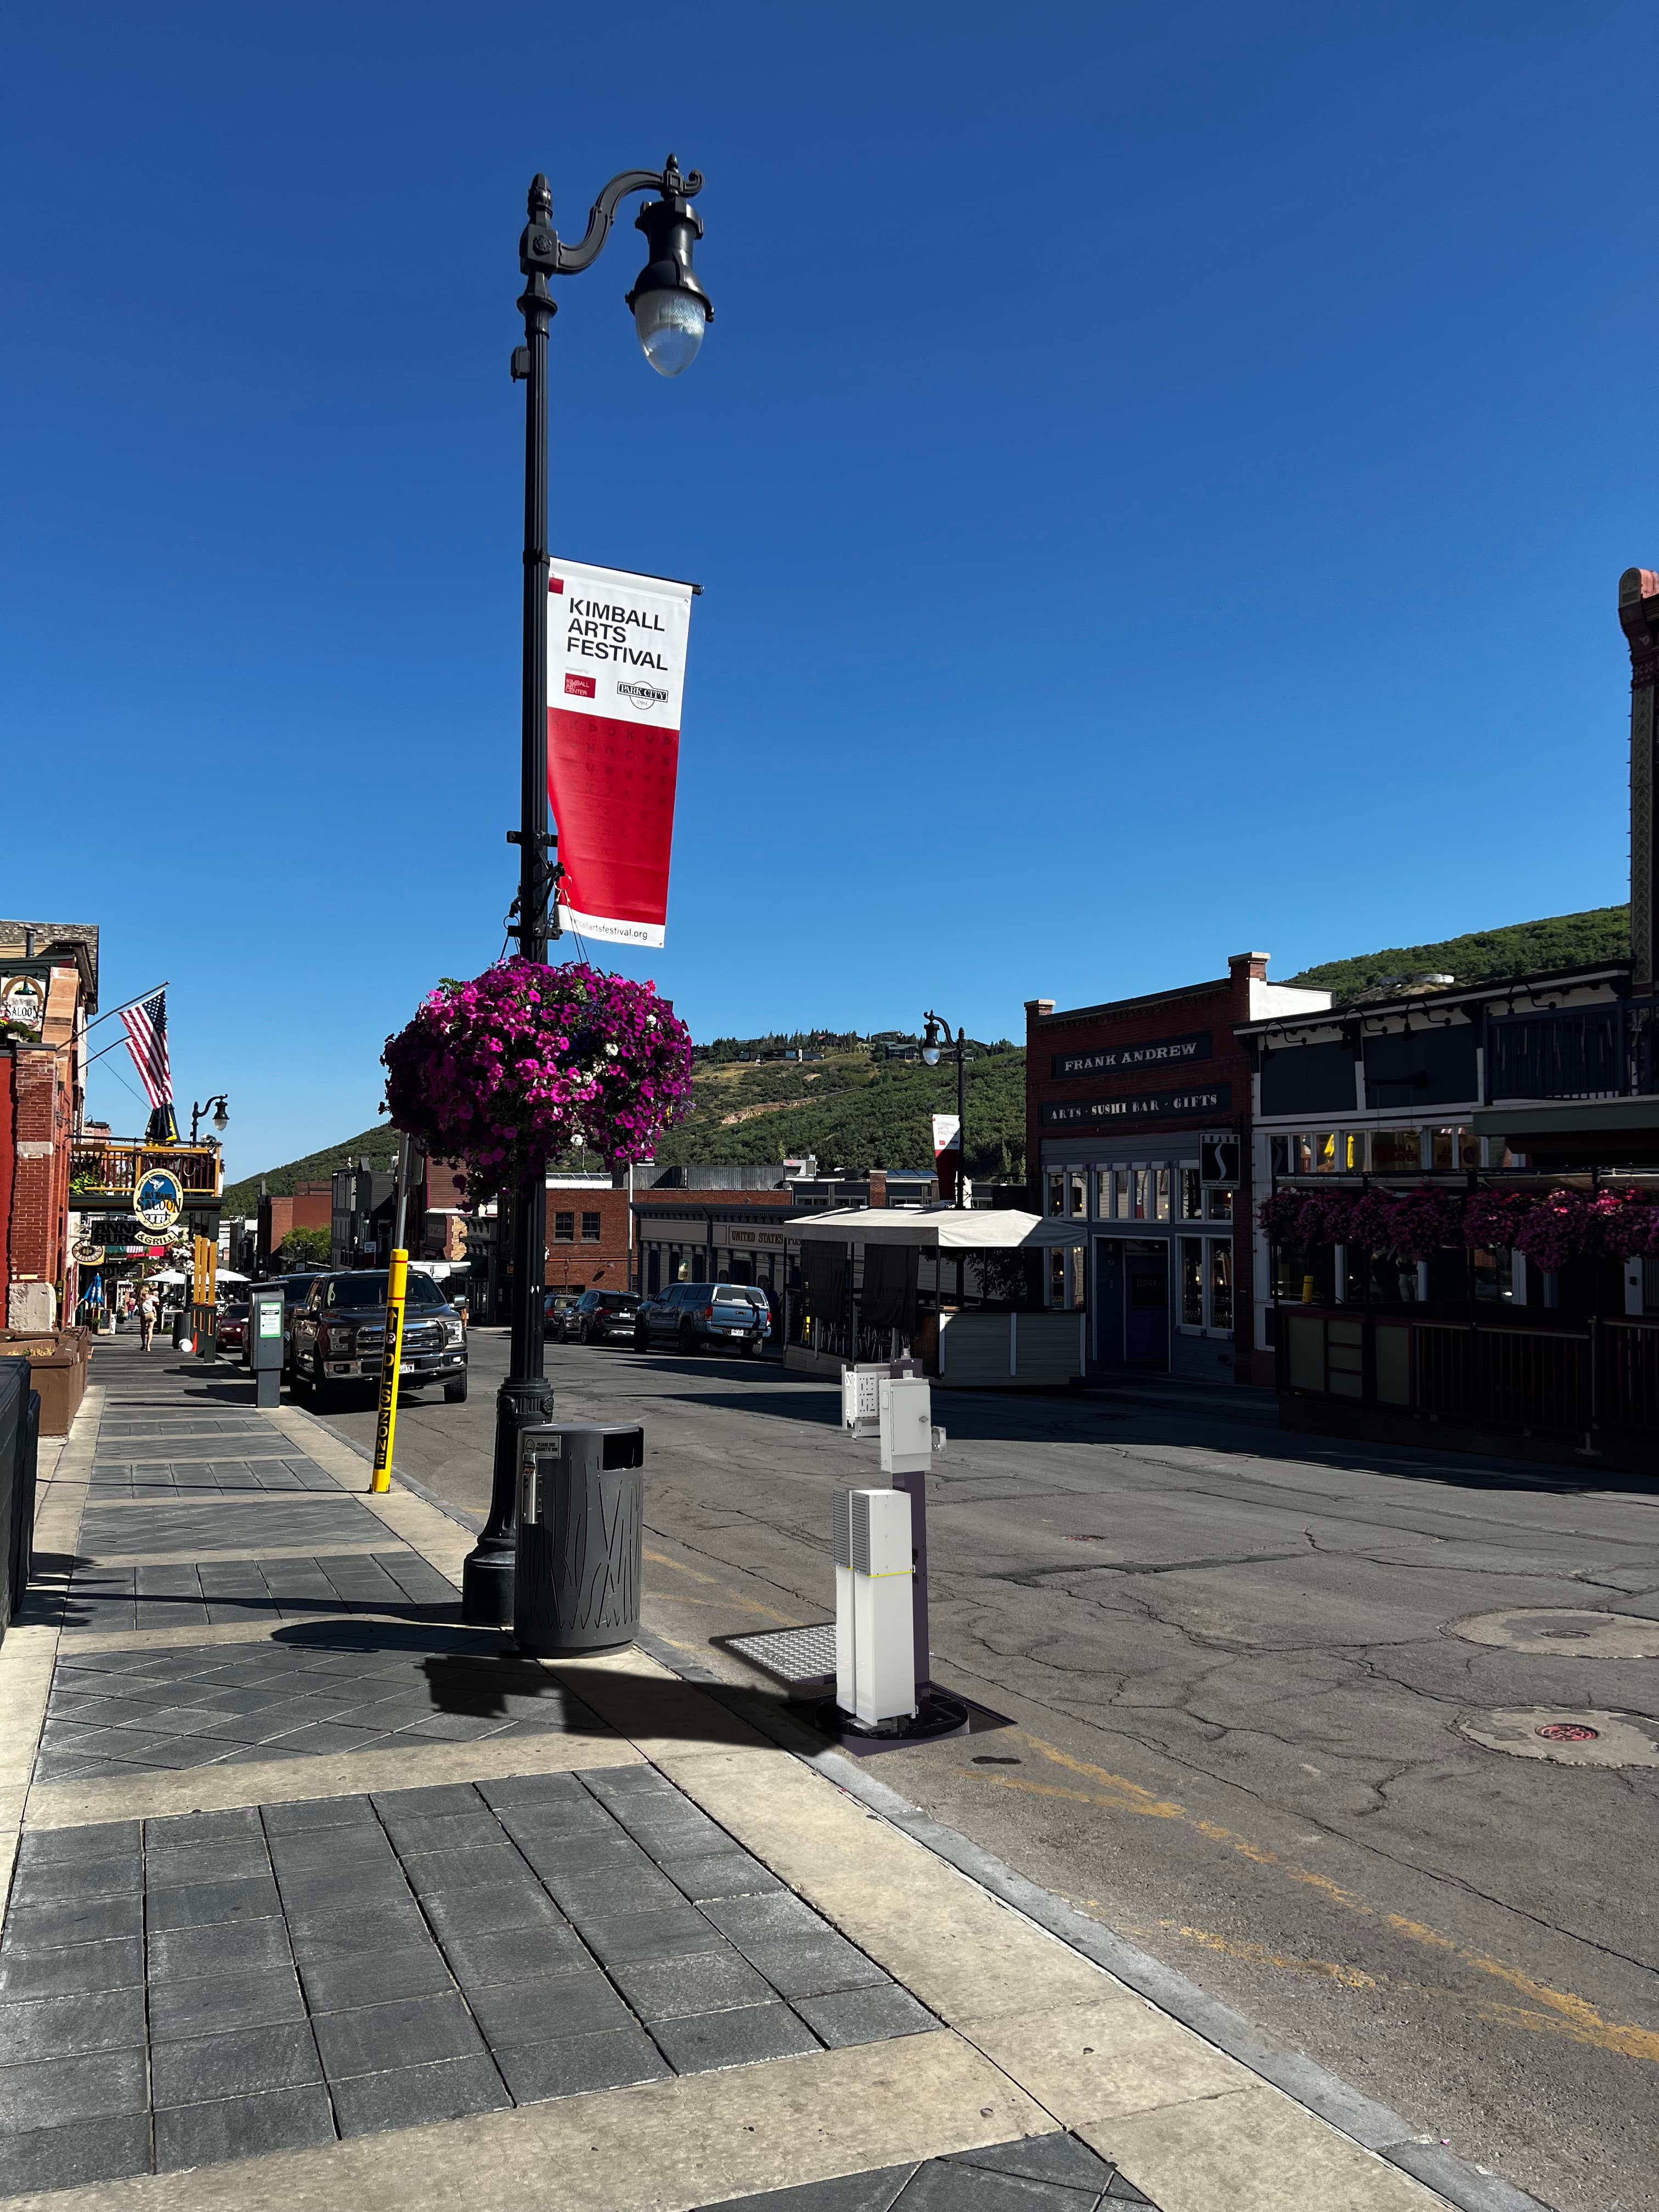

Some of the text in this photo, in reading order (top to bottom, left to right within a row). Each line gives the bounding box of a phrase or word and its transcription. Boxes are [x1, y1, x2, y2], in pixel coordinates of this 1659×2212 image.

[569, 597, 665, 631] KIMBALL
[567, 618, 627, 643] ARTS
[567, 636, 668, 671] FESTIVAL
[565, 687, 588, 696] CENTER
[566, 678, 590, 688] KIMBALL
[620, 684, 665, 699] PARK CITY
[1064, 1042, 1198, 1072] FRANK ANDREW
[1050, 1093, 1218, 1120] ARTS SUSHI BAR GIFTS
[145, 1191, 173, 1200] NO NAME
[136, 1196, 182, 1213] SALOON
[731, 1231, 755, 1242] UNITED
[758, 1233, 783, 1244] STATES
[97, 1267, 119, 1276] 501
[376, 1412, 389, 1465] ZONE
